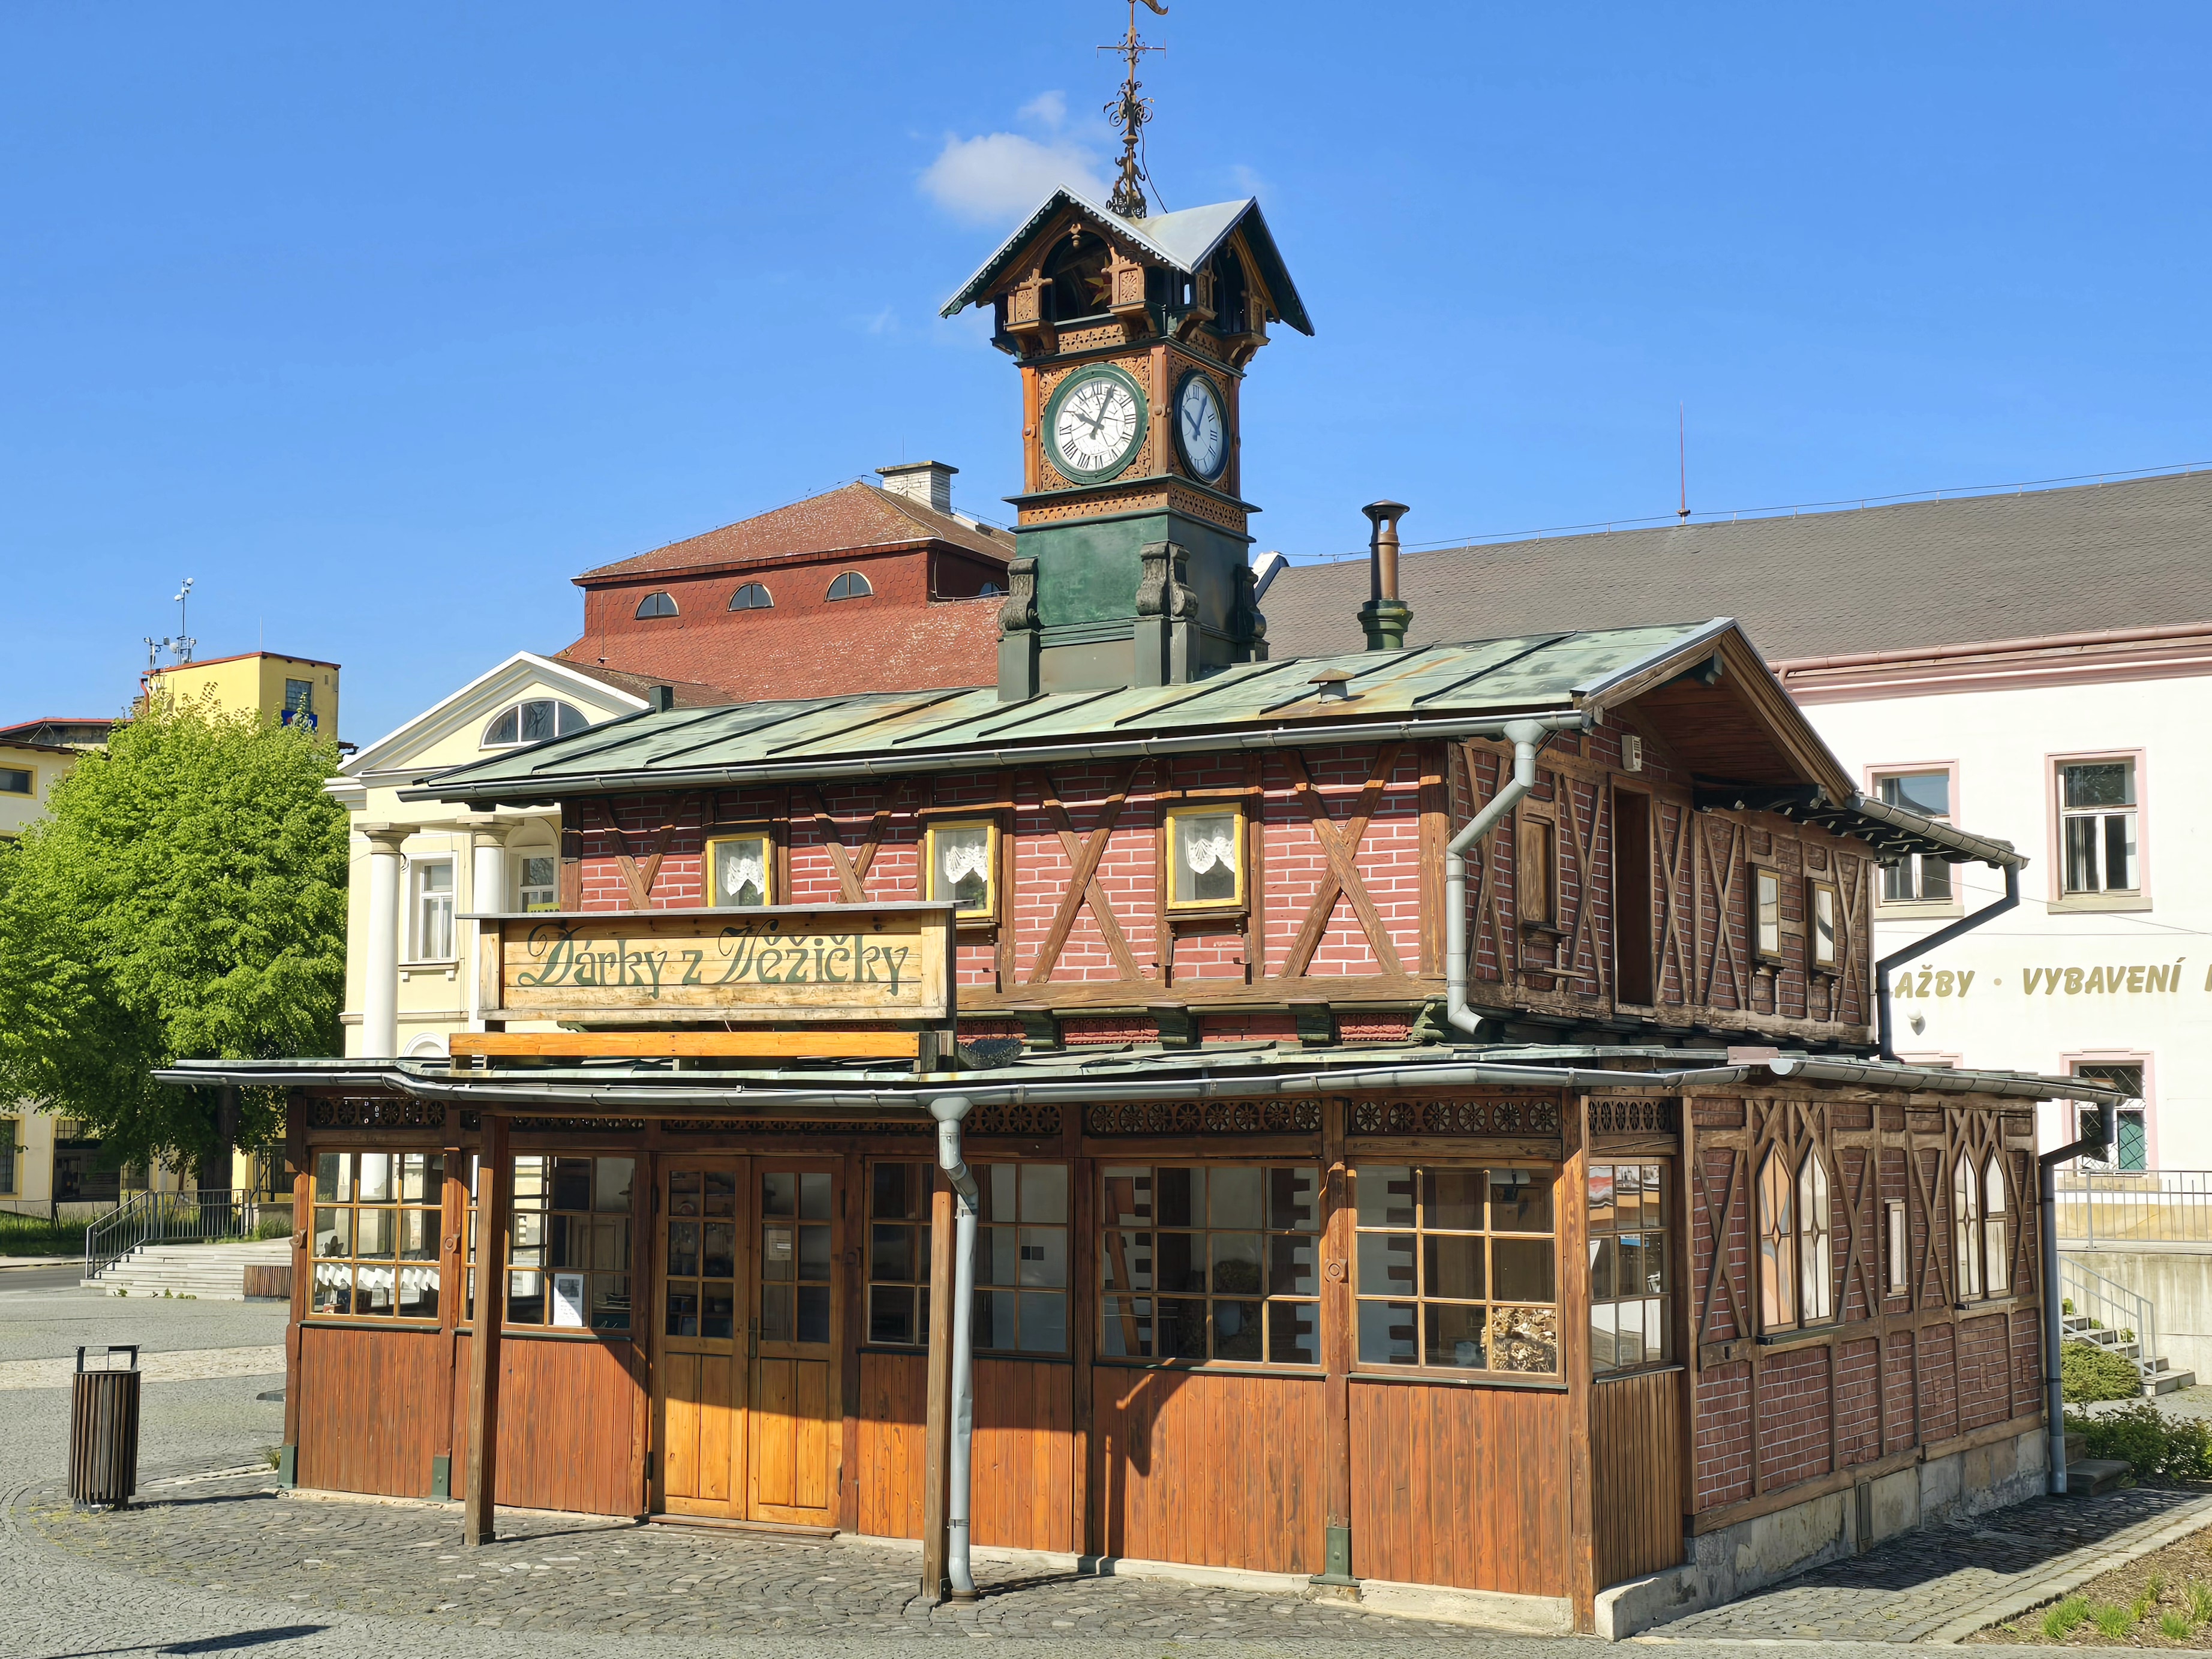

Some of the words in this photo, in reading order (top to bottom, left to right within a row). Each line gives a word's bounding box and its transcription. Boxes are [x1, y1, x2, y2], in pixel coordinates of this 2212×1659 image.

[518, 923, 668, 1000] Dárky
[681, 949, 704, 984] z
[714, 918, 909, 996] Věžičky
[1889, 964, 1976, 999] AŽBY
[2023, 957, 2186, 995] VYBAVENÍ
